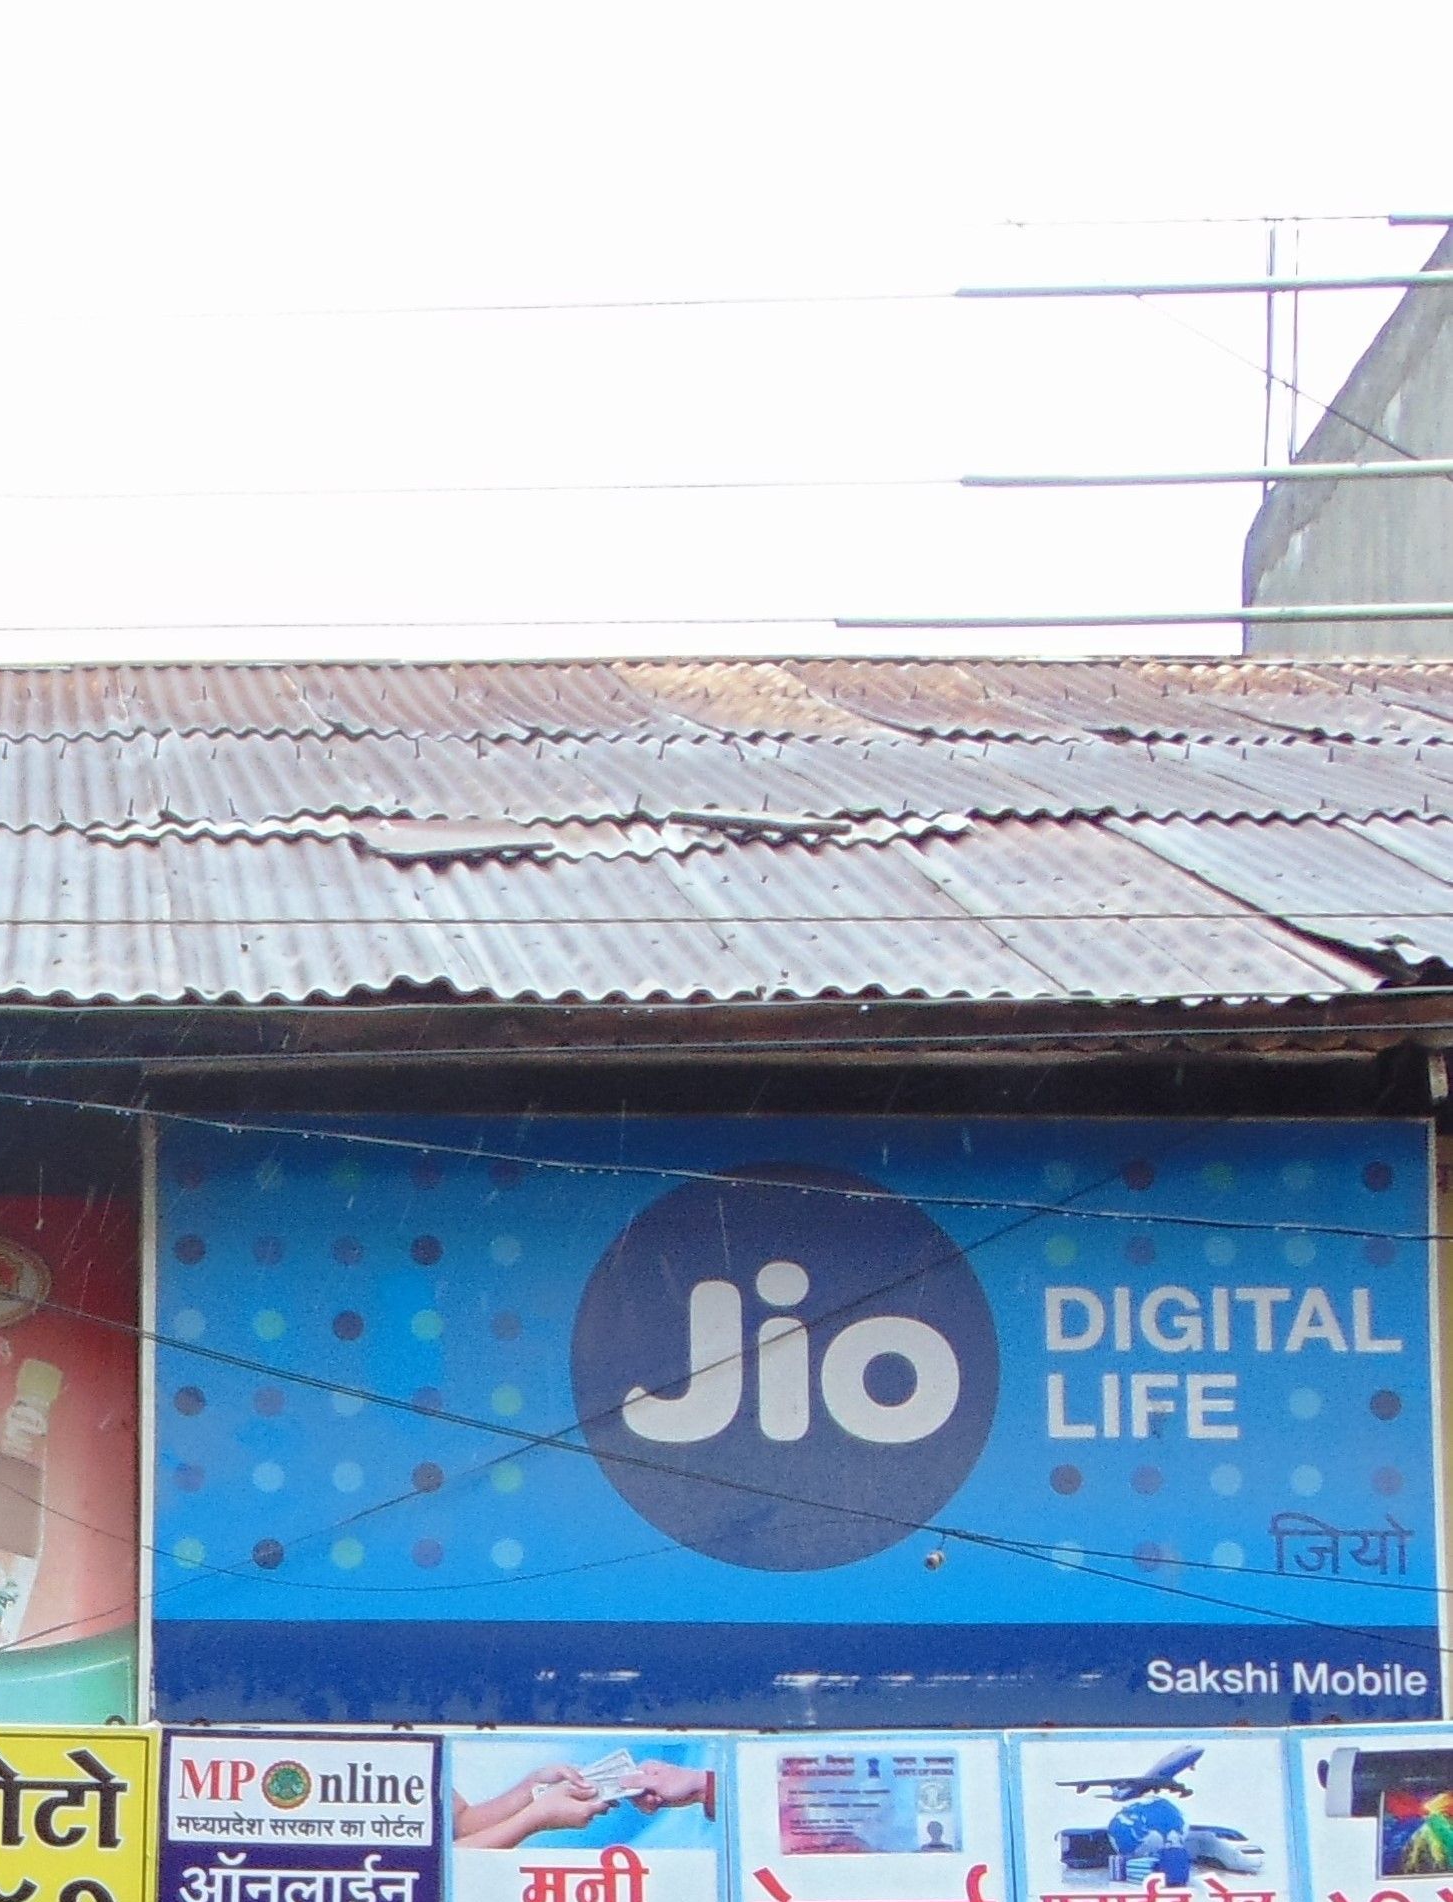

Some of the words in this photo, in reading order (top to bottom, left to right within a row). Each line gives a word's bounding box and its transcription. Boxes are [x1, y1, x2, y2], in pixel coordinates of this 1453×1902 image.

[623, 1262, 960, 1443] Jio
[1045, 1286, 1402, 1354] DIGITAL
[1047, 1373, 1239, 1440] LIFE
[1269, 1512, 1415, 1575] जियो
[1146, 1659, 1279, 1695] Sakshi
[1293, 1661, 1429, 1697] Mobile
[176, 1811, 264, 1836] मध्यप्रदेश
[270, 1818, 334, 1838] सरकार
[339, 1819, 365, 1839] का
[370, 1814, 425, 1839] पोर्टल
